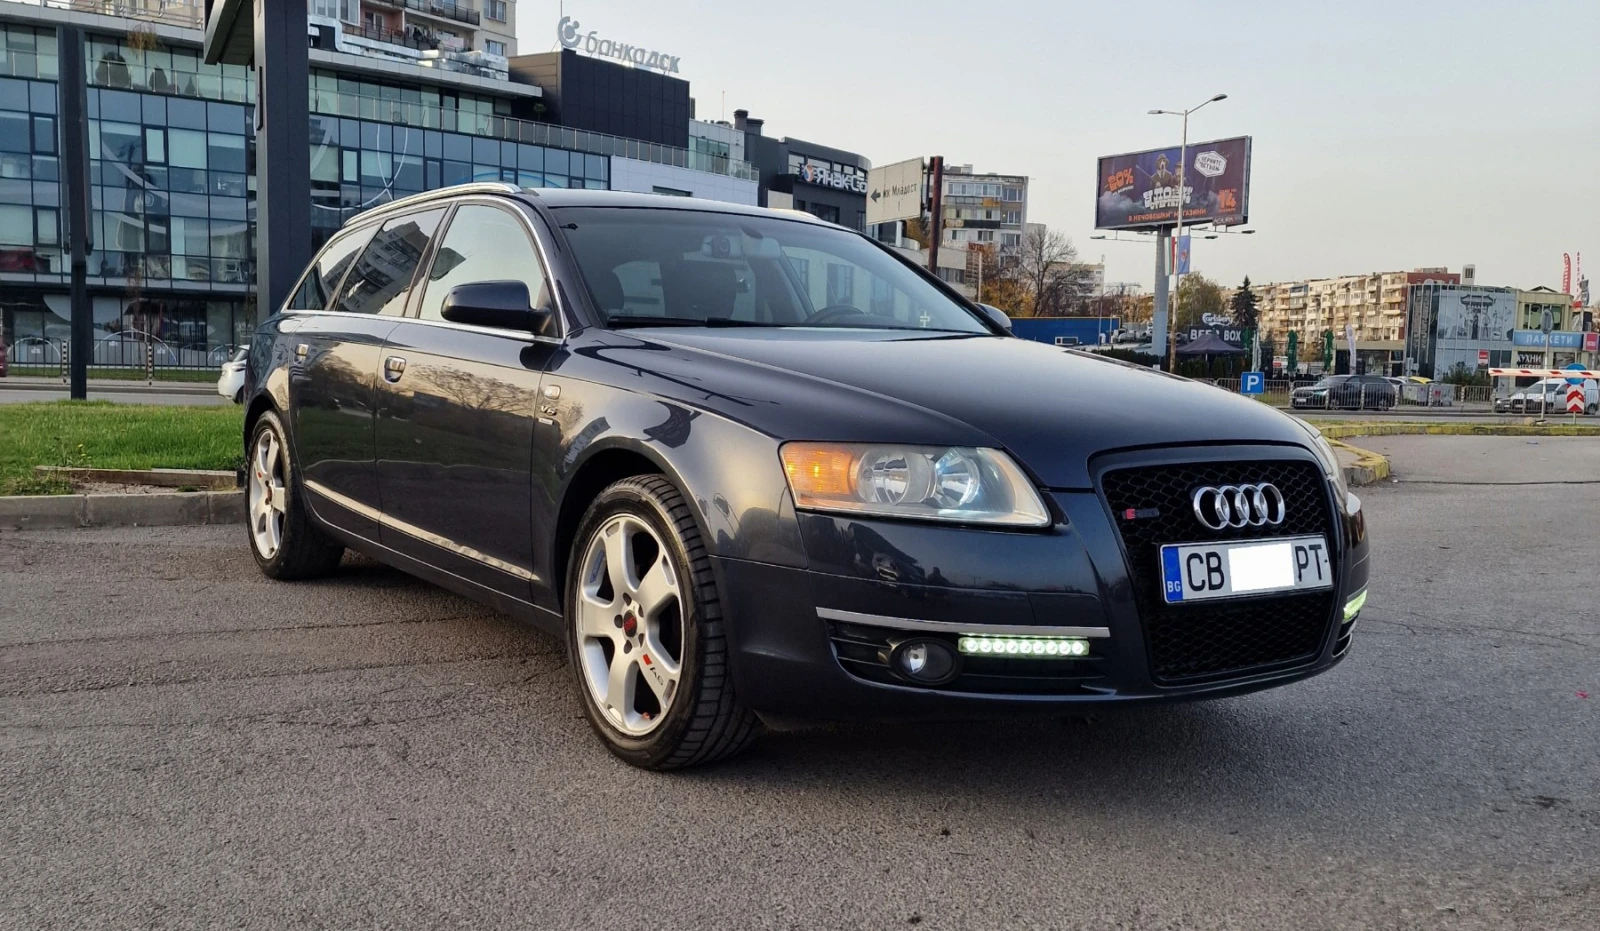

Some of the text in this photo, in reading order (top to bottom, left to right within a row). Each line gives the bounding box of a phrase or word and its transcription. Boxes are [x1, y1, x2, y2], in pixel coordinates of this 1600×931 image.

[892, 183, 917, 196] Младост
[1173, 208, 1207, 218] МГАЗИНИ
[1202, 313, 1233, 326] Carlsberg
[1224, 330, 1241, 341] BOX
[1517, 354, 1541, 363] КУХНИ
[1247, 375, 1259, 391] P
[1186, 544, 1322, 592] CB PT
[1167, 580, 1181, 592] BG
